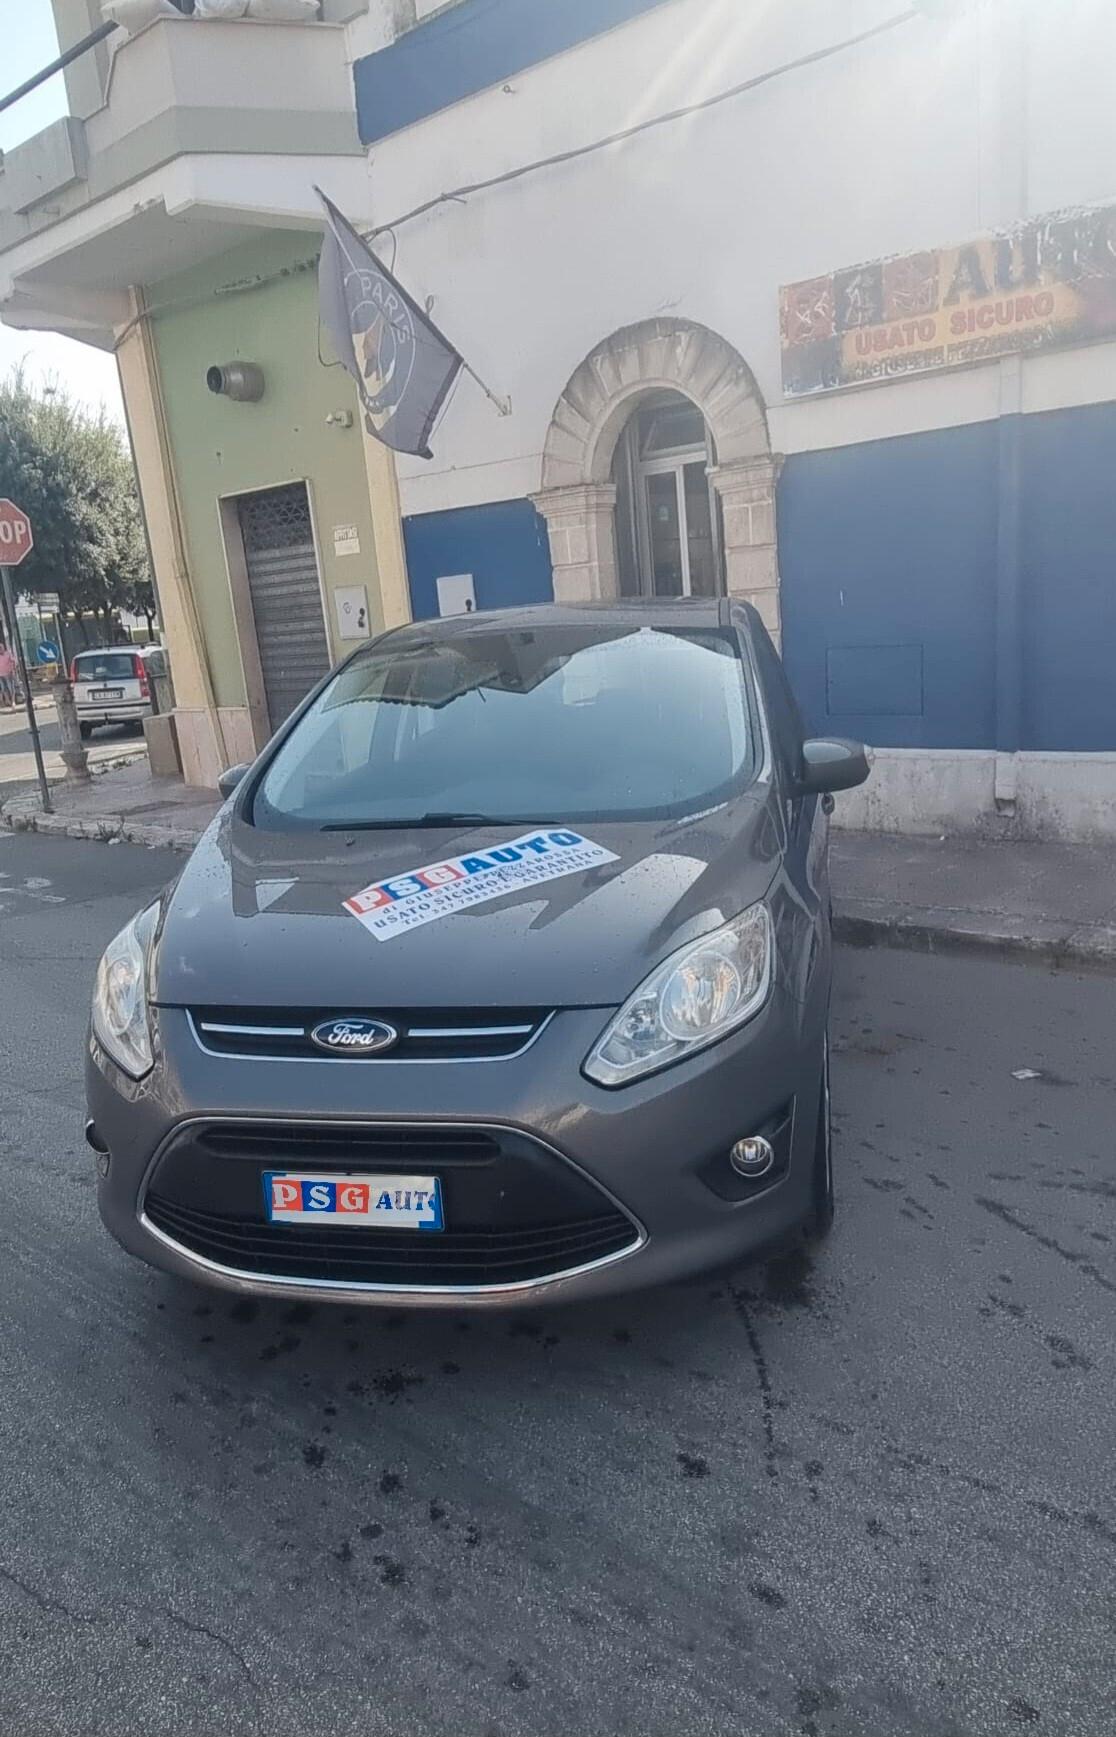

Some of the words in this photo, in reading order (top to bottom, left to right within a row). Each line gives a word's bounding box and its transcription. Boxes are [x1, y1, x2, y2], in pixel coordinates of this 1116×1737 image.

[360, 276, 411, 344] PARIS
[855, 317, 937, 356] USATO
[949, 291, 1055, 336] SICURO
[0, 519, 26, 545] OP
[348, 863, 464, 914] PSG
[459, 831, 583, 875] AUTO
[373, 902, 431, 929] USATO
[433, 880, 498, 905] SICURO
[514, 849, 604, 879] GARANTITO
[382, 905, 397, 915] di
[327, 1023, 376, 1045] Ford
[272, 1182, 365, 1211] PSG
